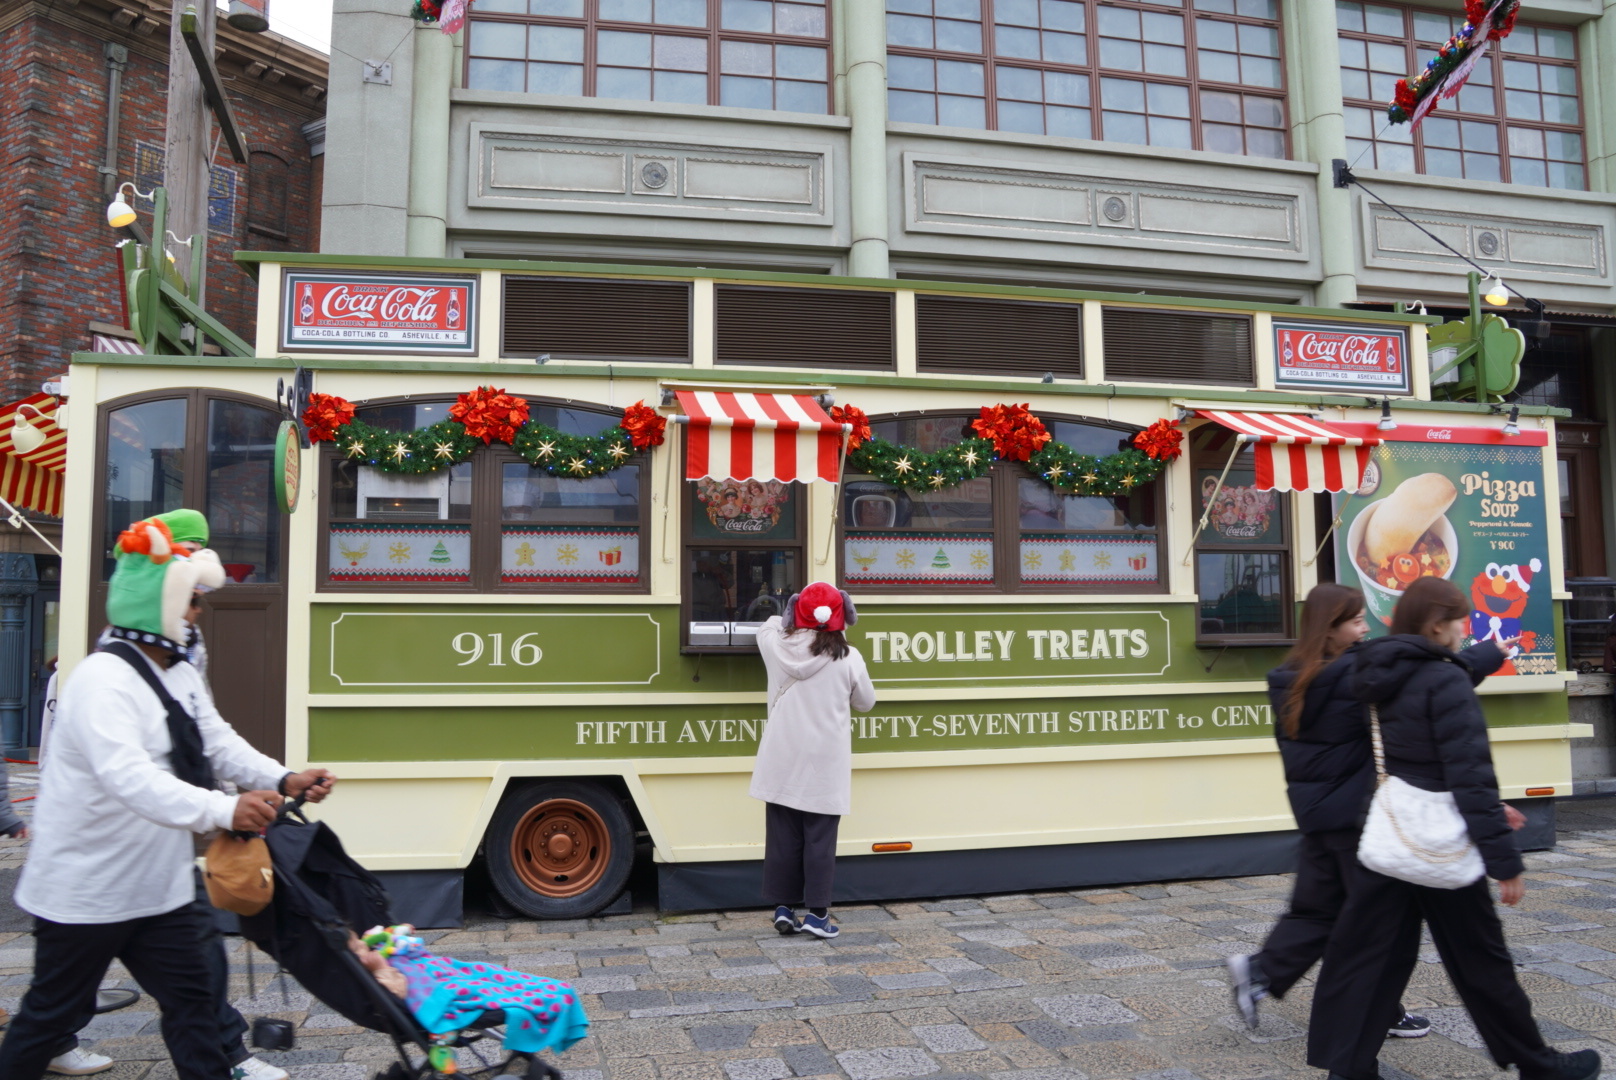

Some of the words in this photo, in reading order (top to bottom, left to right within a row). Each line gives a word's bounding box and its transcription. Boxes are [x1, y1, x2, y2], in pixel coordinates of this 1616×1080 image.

[321, 285, 441, 321] Coca-Cola
[301, 329, 341, 337] COCA-COLA
[343, 330, 376, 338] BOTTLING
[317, 319, 365, 327] DELICIOUS
[1297, 333, 1381, 365] Coca-Cola
[1426, 428, 1452, 440] Coca-Cola
[1460, 471, 1537, 502] Pizza
[1480, 498, 1519, 518] SOUP
[725, 519, 763, 531] Coca-Cola
[1225, 525, 1257, 537] Coca-Cola
[451, 632, 543, 666] 916
[865, 630, 1016, 663] TROLLEY
[1026, 628, 1150, 660] TREATS
[575, 720, 667, 745] FIFTH
[1068, 708, 1170, 733] STREET
[1176, 713, 1204, 729] to
